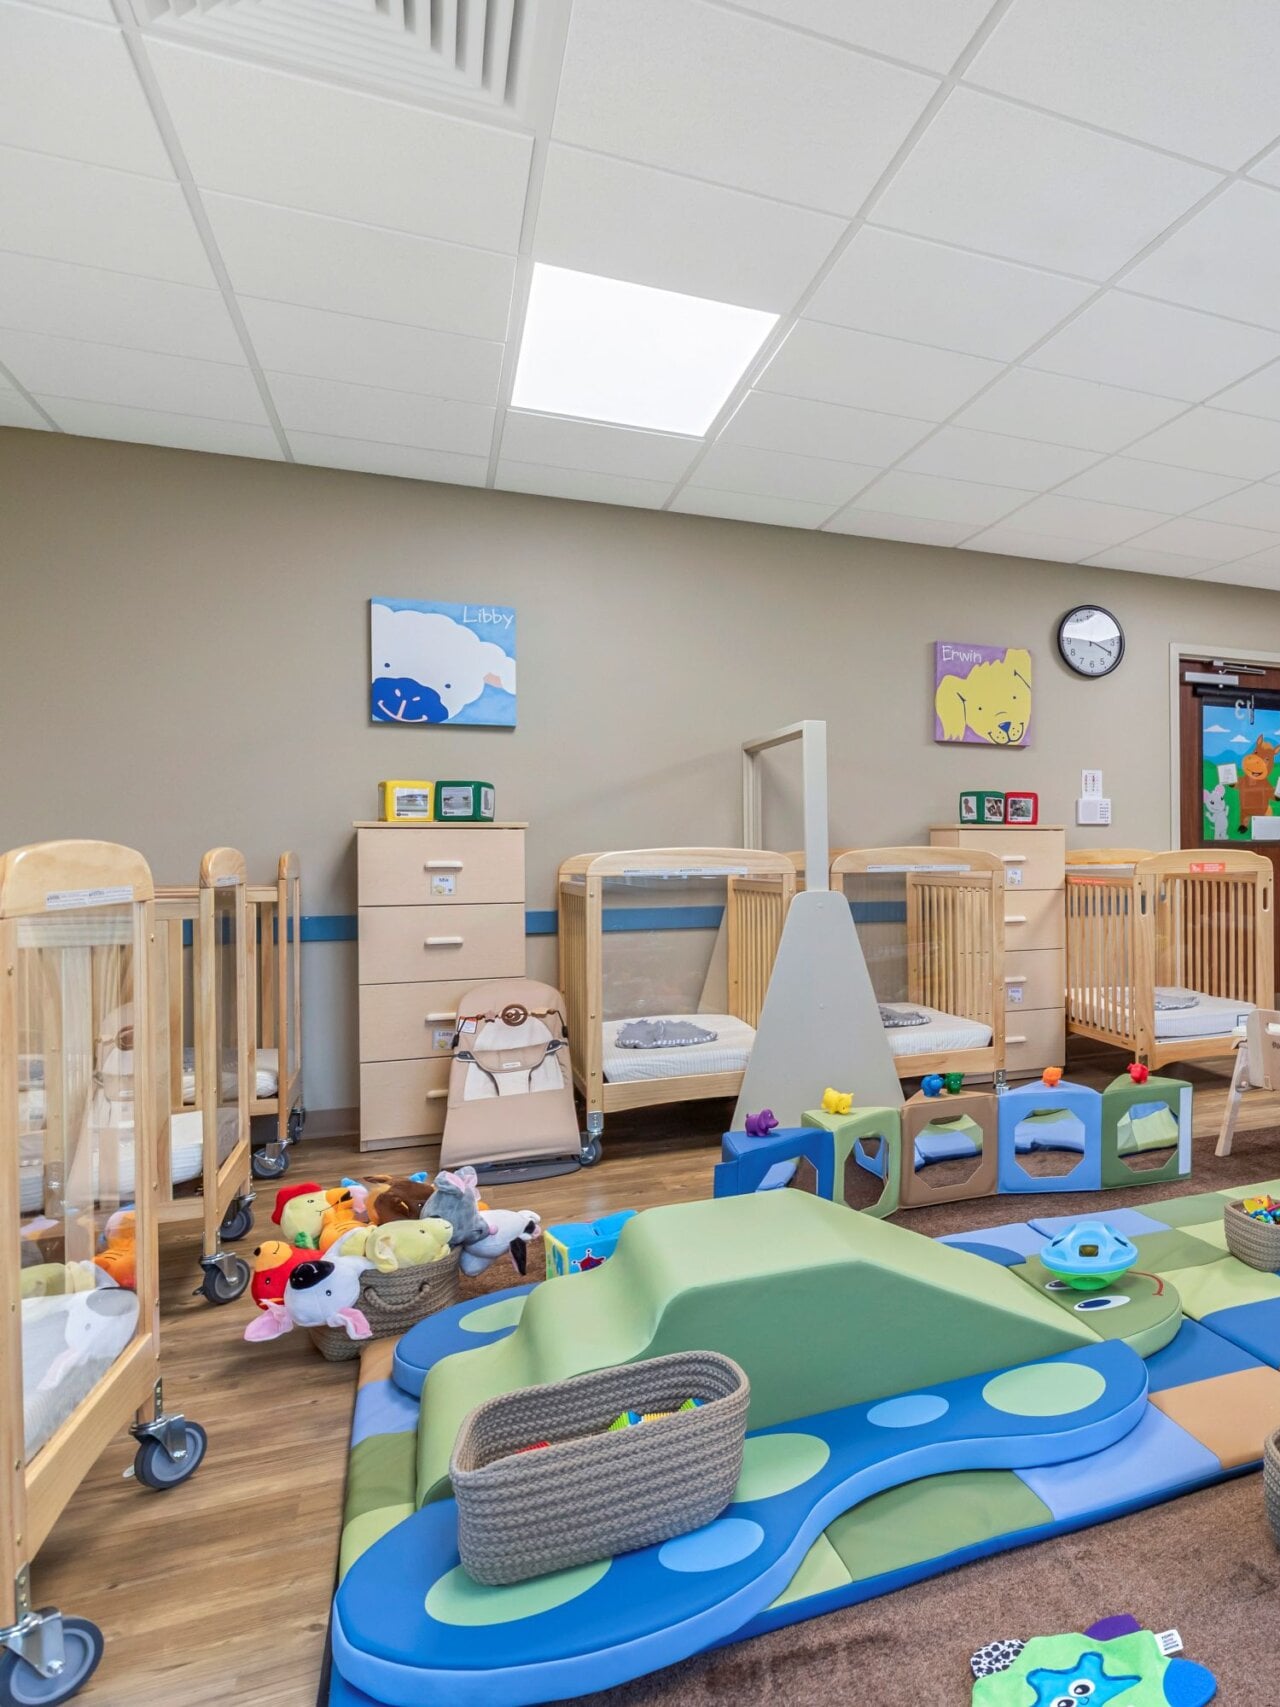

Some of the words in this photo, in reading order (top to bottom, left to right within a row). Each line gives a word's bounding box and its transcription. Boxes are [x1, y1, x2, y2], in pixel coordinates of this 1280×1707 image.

[463, 605, 514, 630] Libby
[942, 645, 982, 663] Erwin
[1070, 648, 1076, 657] 8
[1080, 657, 1085, 665] 7
[1099, 657, 1105, 666] 5
[1089, 660, 1095, 668] 6
